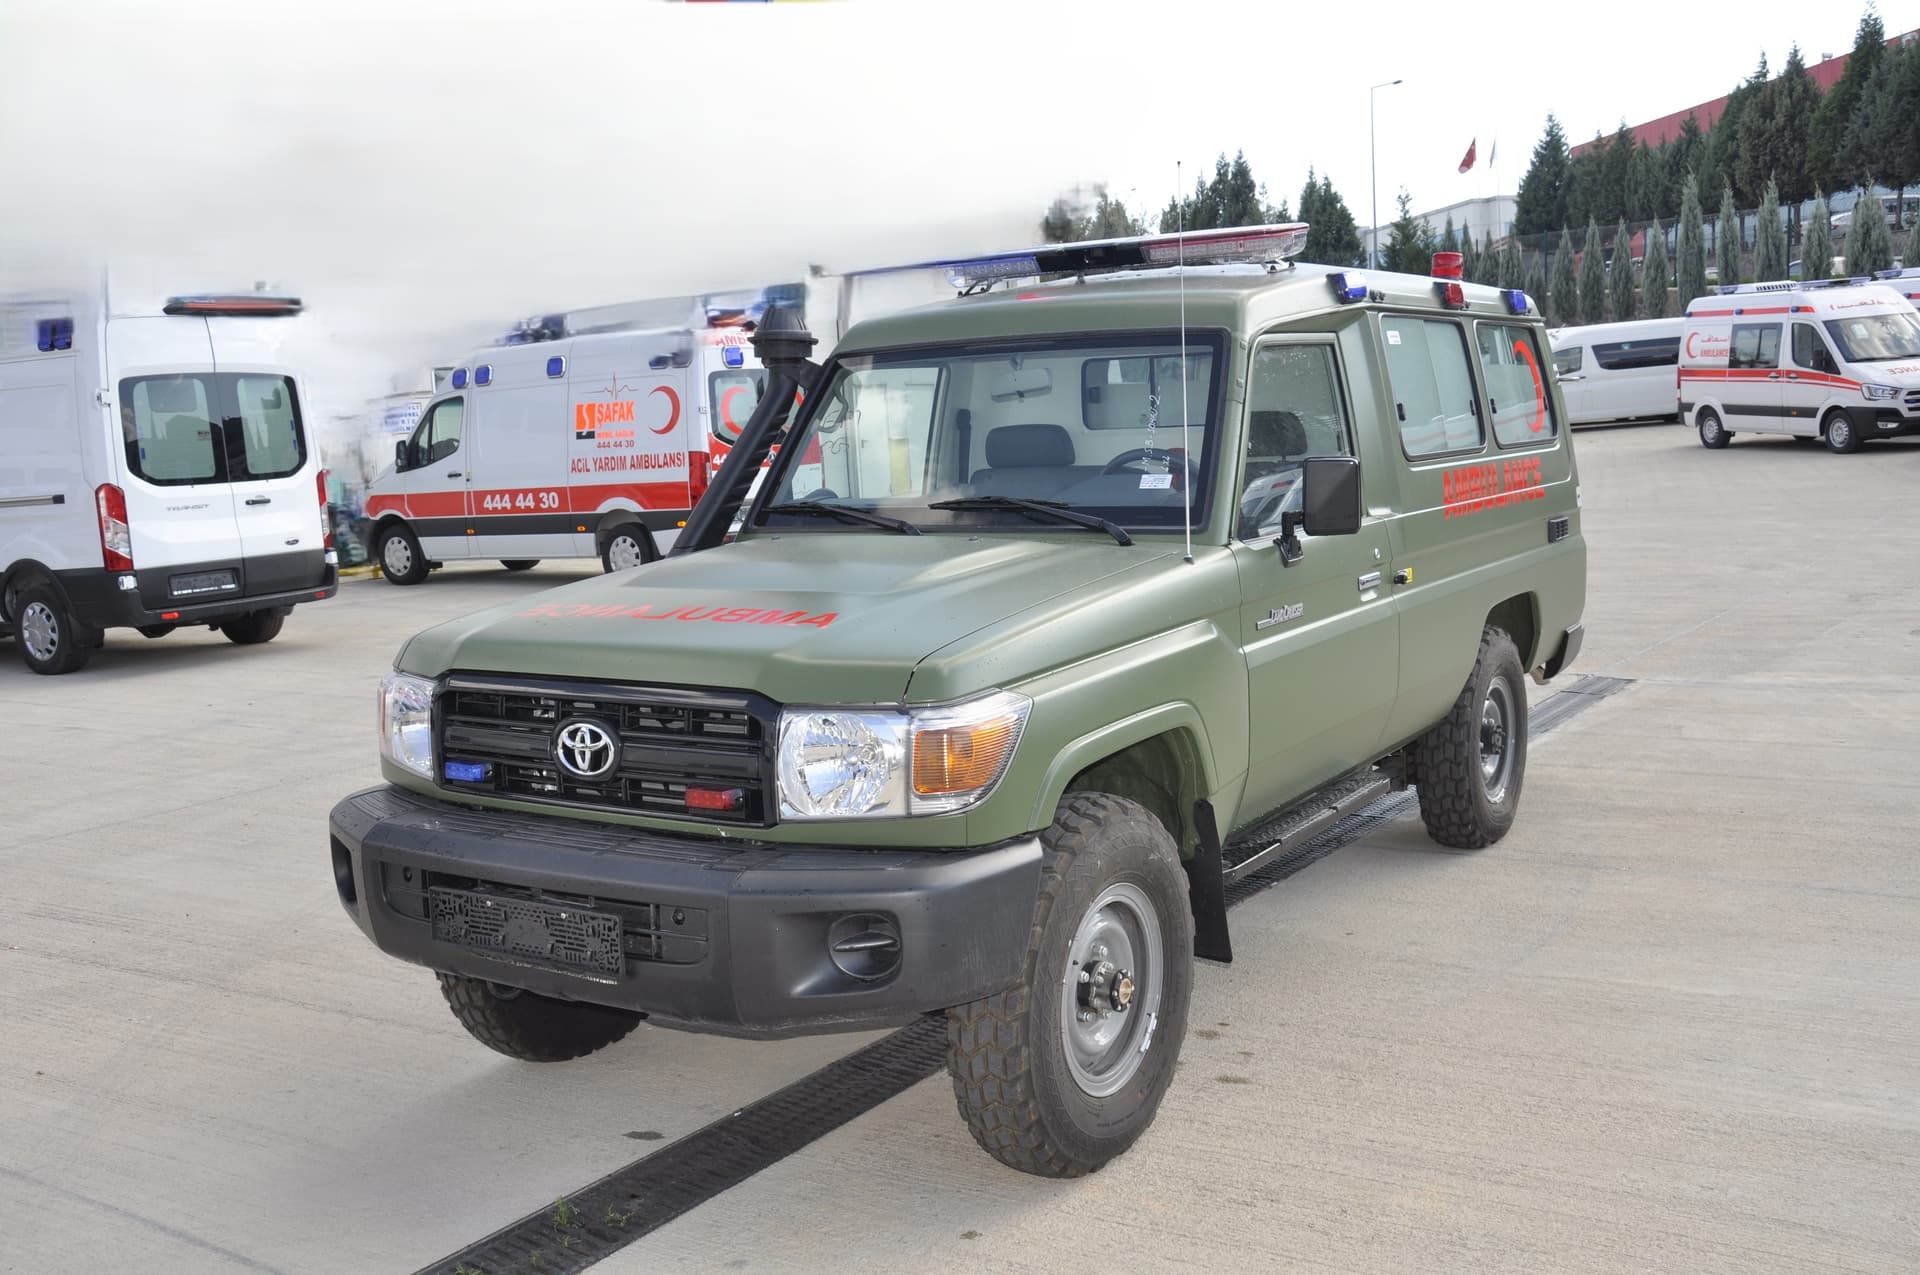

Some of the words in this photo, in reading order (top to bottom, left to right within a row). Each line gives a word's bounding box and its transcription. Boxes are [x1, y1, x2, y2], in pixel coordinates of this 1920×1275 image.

[597, 400, 635, 428] ŞAFAK
[612, 440, 623, 448] 44
[625, 440, 635, 448] 30
[592, 455, 627, 472] YARDIM
[1443, 456, 1545, 521] AMBULANCE
[483, 494, 512, 511] 444
[515, 492, 536, 510] 44
[539, 492, 559, 509] 30
